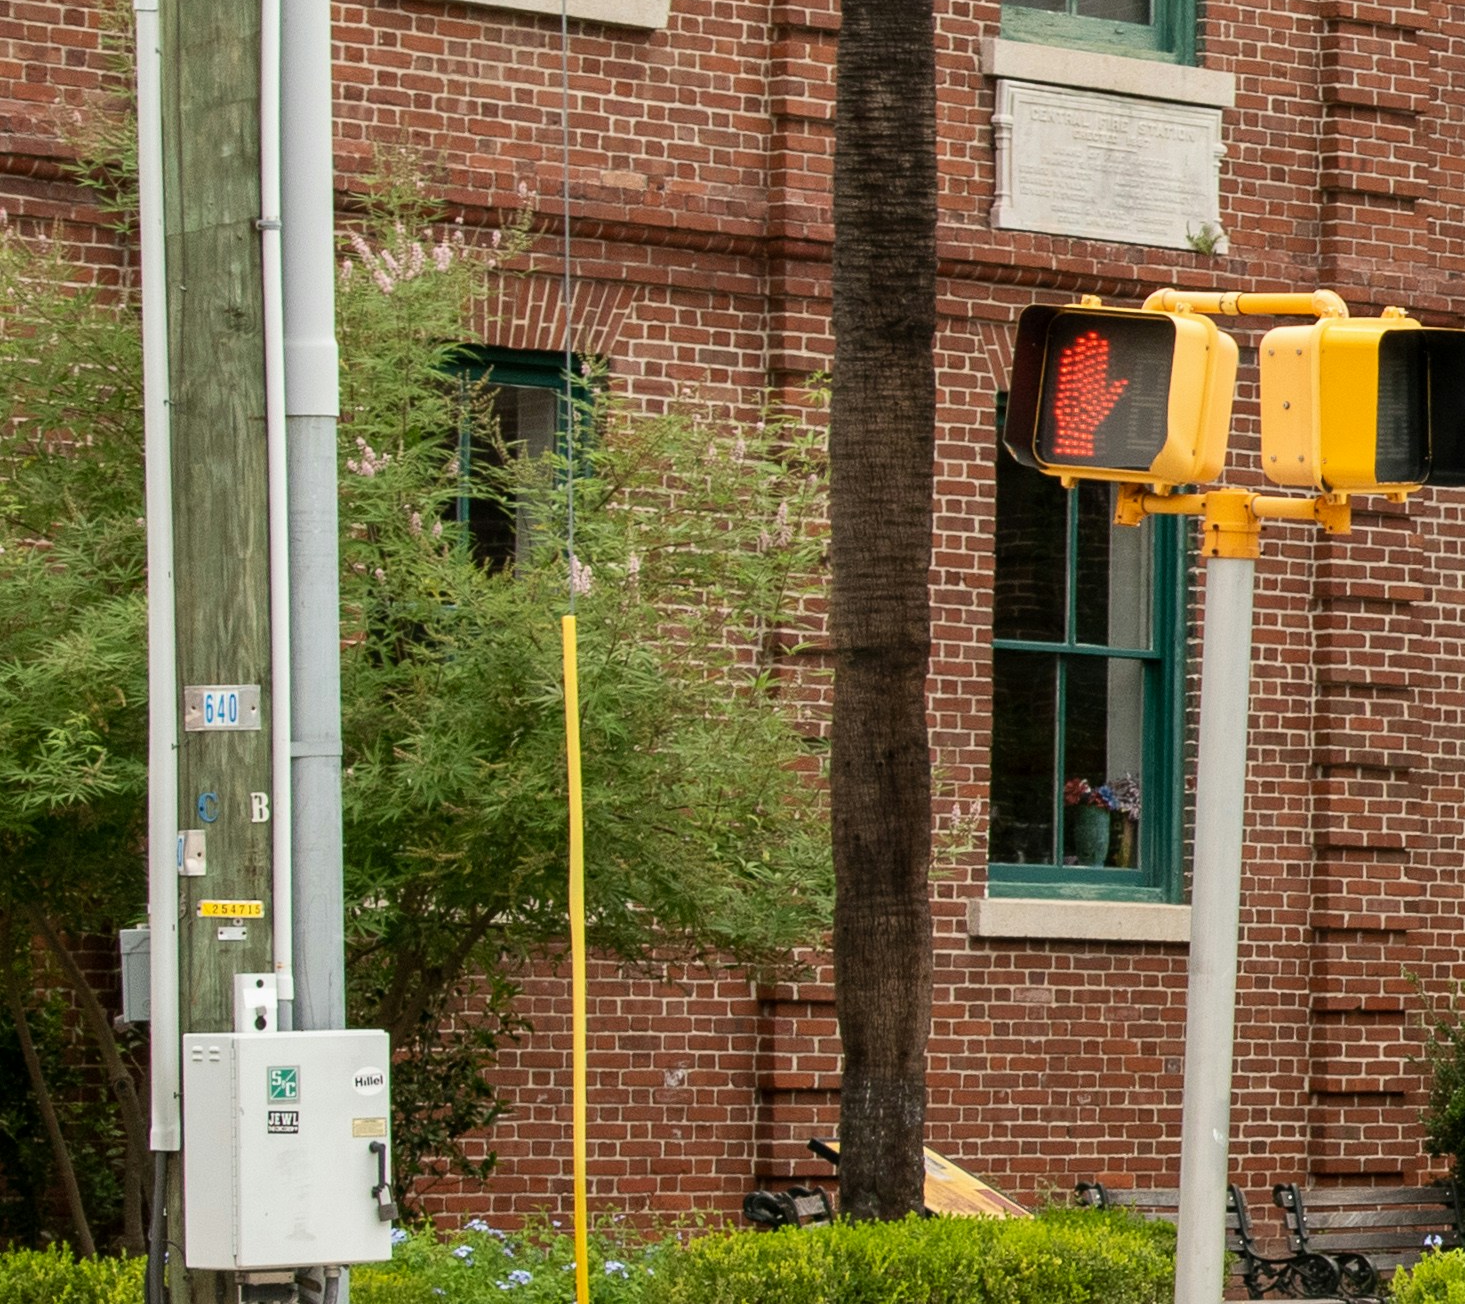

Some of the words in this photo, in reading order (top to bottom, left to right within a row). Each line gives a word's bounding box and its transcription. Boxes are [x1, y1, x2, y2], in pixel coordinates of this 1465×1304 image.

[1030, 107, 1089, 128] CENTRAL
[1098, 116, 1130, 134] FIRE
[1137, 120, 1196, 143] STATION
[205, 693, 237, 724] 640
[197, 792, 219, 822] C
[250, 792, 270, 823] B
[355, 1074, 384, 1087] Hillel
[268, 1112, 299, 1126] JEWL
